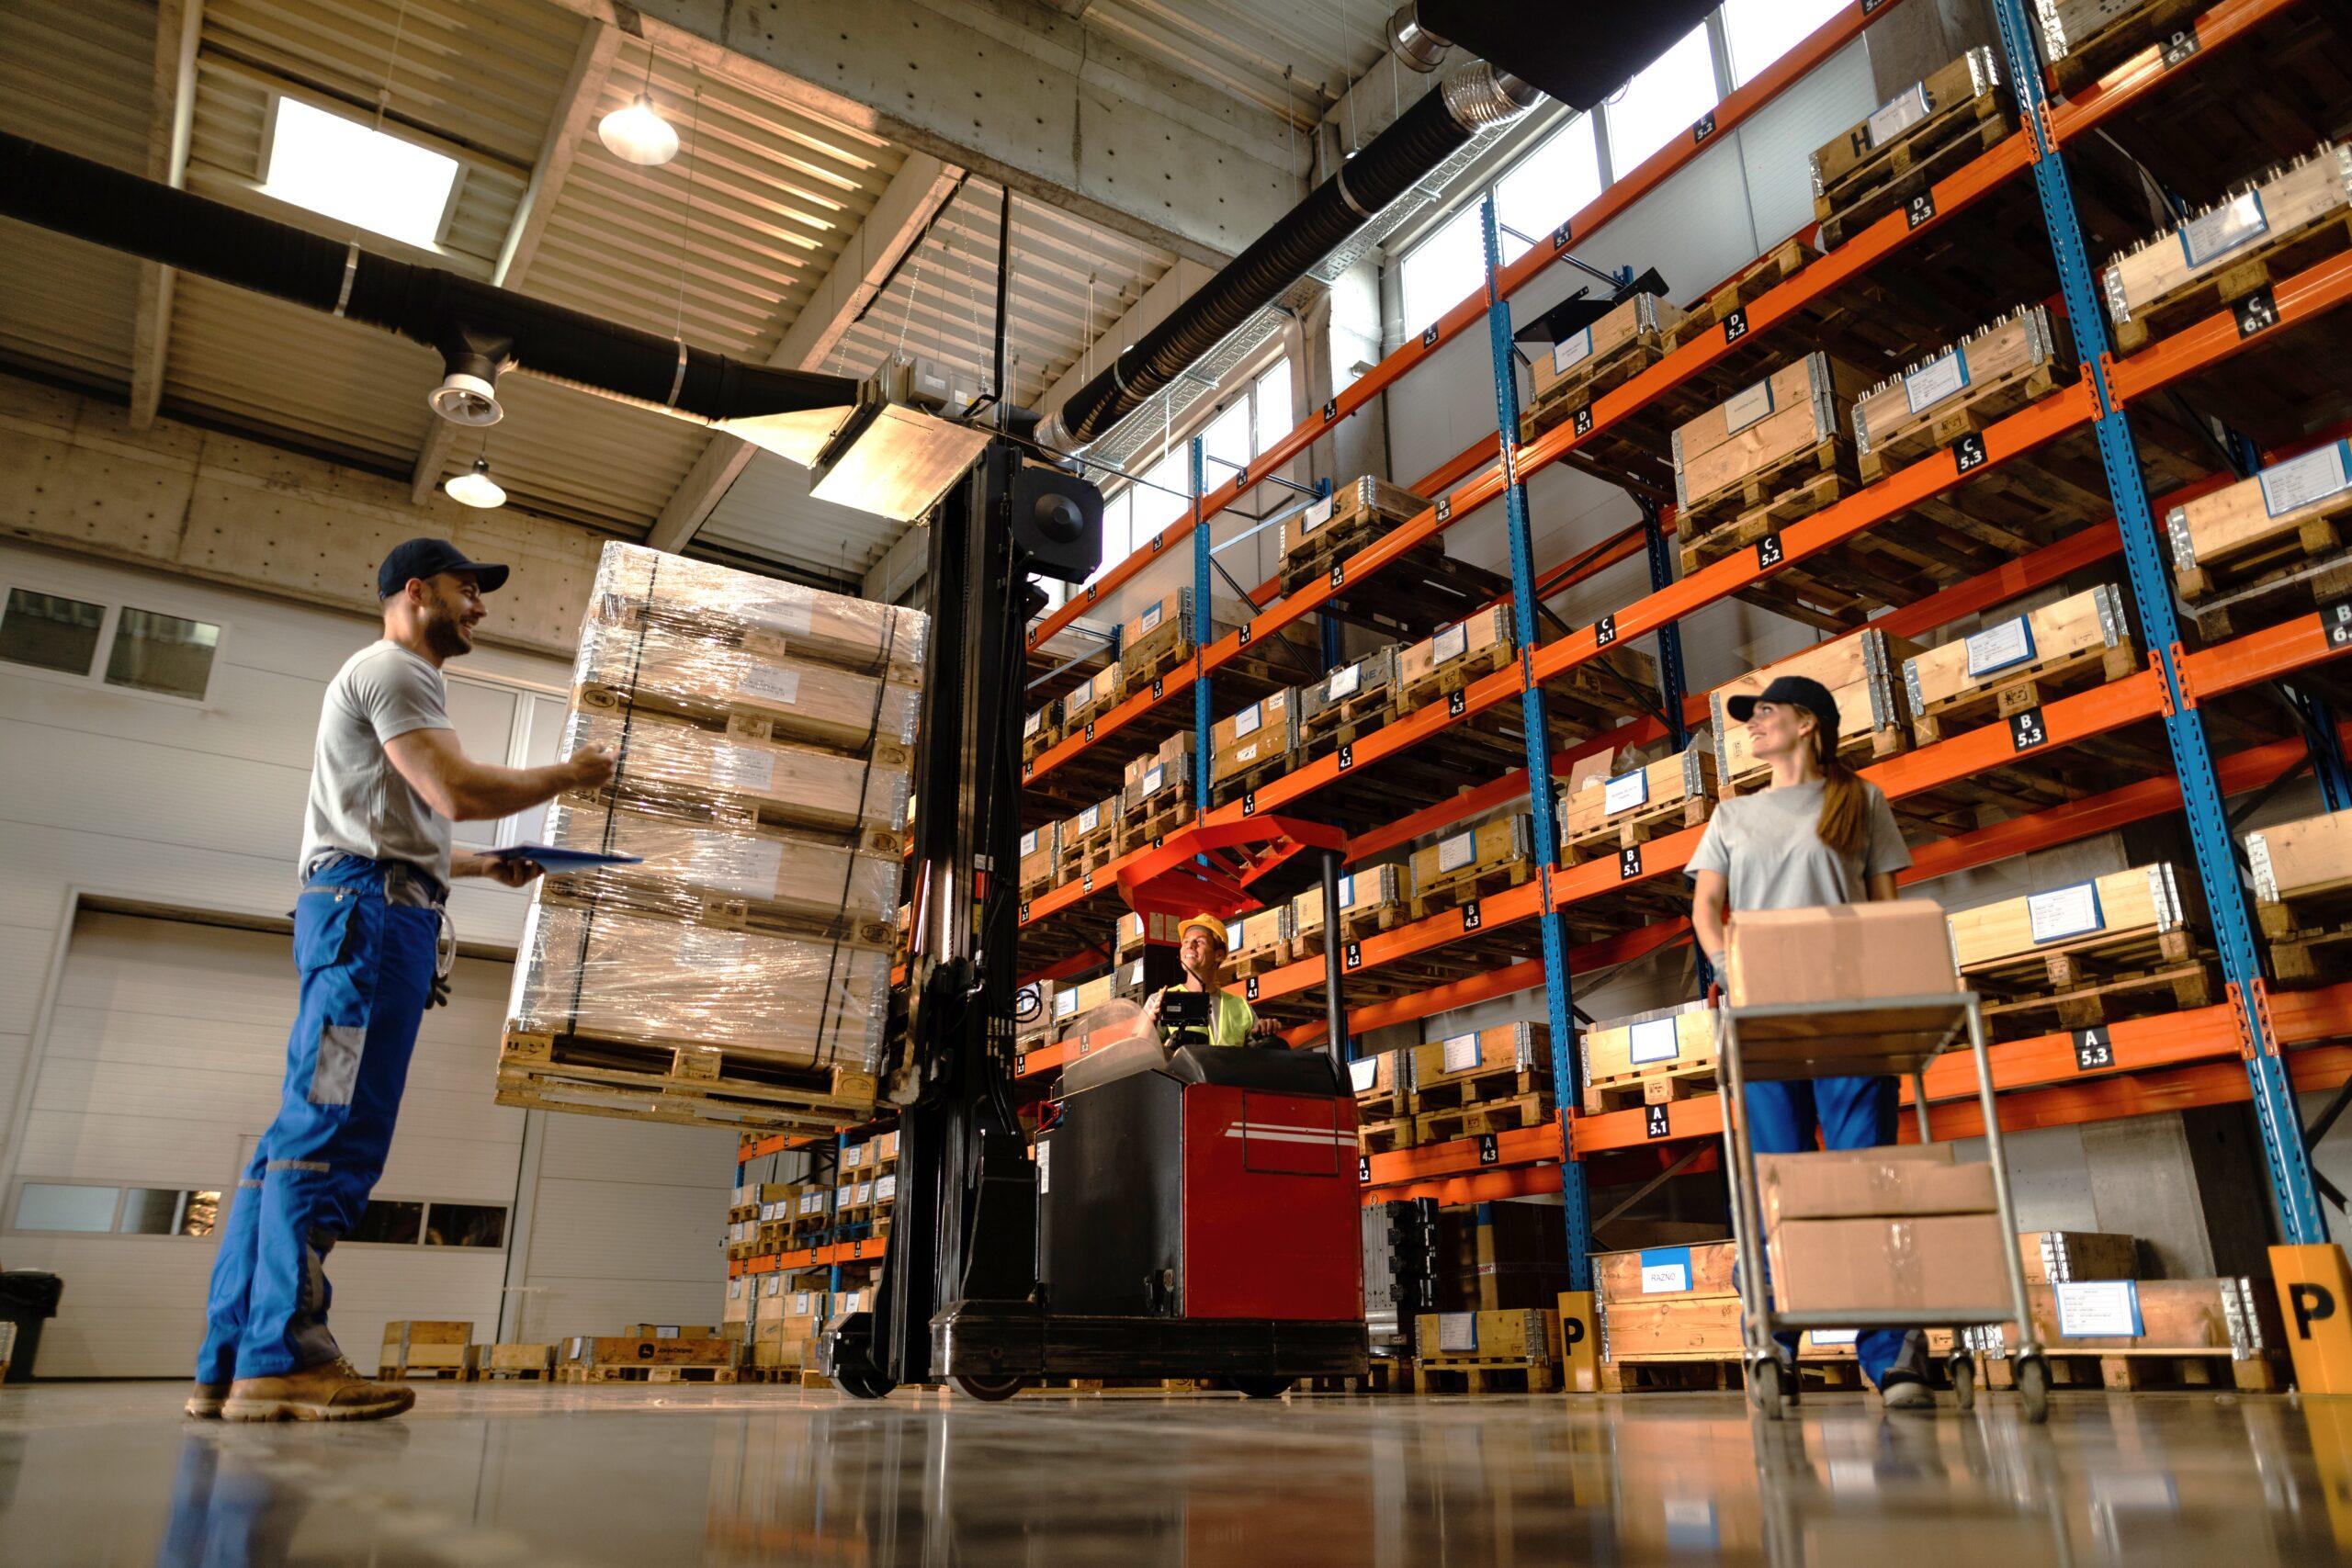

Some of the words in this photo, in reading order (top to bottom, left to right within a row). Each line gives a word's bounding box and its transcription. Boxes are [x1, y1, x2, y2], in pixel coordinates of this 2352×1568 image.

[1866, 0, 1883, 12] 5.
[2172, 31, 2185, 46] D
[2168, 40, 2194, 63] 6.1
[1698, 122, 1713, 140] 5.2
[1914, 197, 1924, 210] D
[1911, 206, 1931, 226] 5.3
[1556, 231, 1569, 247] 5.1
[2248, 297, 2261, 312] C
[1730, 314, 1738, 326] D
[2244, 310, 2272, 333] 6.1
[1728, 322, 1745, 340] 5.2
[1425, 333, 1436, 344] 4.3
[1326, 409, 1335, 420] 4.2
[1579, 411, 1587, 422] D
[1577, 419, 1590, 434] 5.1
[1963, 438, 1973, 451] C
[1961, 450, 1982, 469] 5.3
[1440, 501, 1446, 510] D
[1437, 509, 1450, 521] 4.3
[1764, 538, 1773, 549] C
[1762, 549, 1780, 566] 5.2
[1334, 568, 1340, 576] D
[1332, 575, 1342, 586] 4.2
[2336, 604, 2352, 622] B
[1601, 618, 1609, 629] C
[1241, 634, 1250, 643] 4.1
[1600, 629, 1613, 644] 5.1
[2334, 626, 2352, 642] 6.
[1454, 693, 1459, 702] C
[1452, 703, 1464, 714] 4.3
[2020, 715, 2032, 728] B
[2018, 728, 2042, 747] 5.3
[1342, 748, 1348, 757] C
[1340, 758, 1351, 768] 4.2
[1247, 795, 1251, 803] C
[1244, 805, 1253, 814] 4.1
[1156, 839, 1160, 847] C
[1626, 850, 1634, 863] B
[1624, 862, 1639, 876] 5.1
[1469, 905, 1475, 915] B
[1465, 916, 1478, 927] 4.3
[1351, 945, 1356, 954] B
[1349, 955, 1360, 965] 4.2
[1250, 978, 1255, 987] B
[1248, 988, 1258, 998] 4.1
[2085, 1030, 2098, 1046] A
[2082, 1047, 2109, 1066] 5.3
[1653, 1107, 1662, 1120] A
[1650, 1121, 1667, 1134] 5.1
[1486, 1137, 1491, 1148] A
[1483, 1150, 1496, 1161] 4.3
[1360, 1158, 1365, 1168] A
[1650, 1272, 1676, 1281] RAZNO
[2288, 1282, 2335, 1340] P
[1564, 1317, 1584, 1356] P
